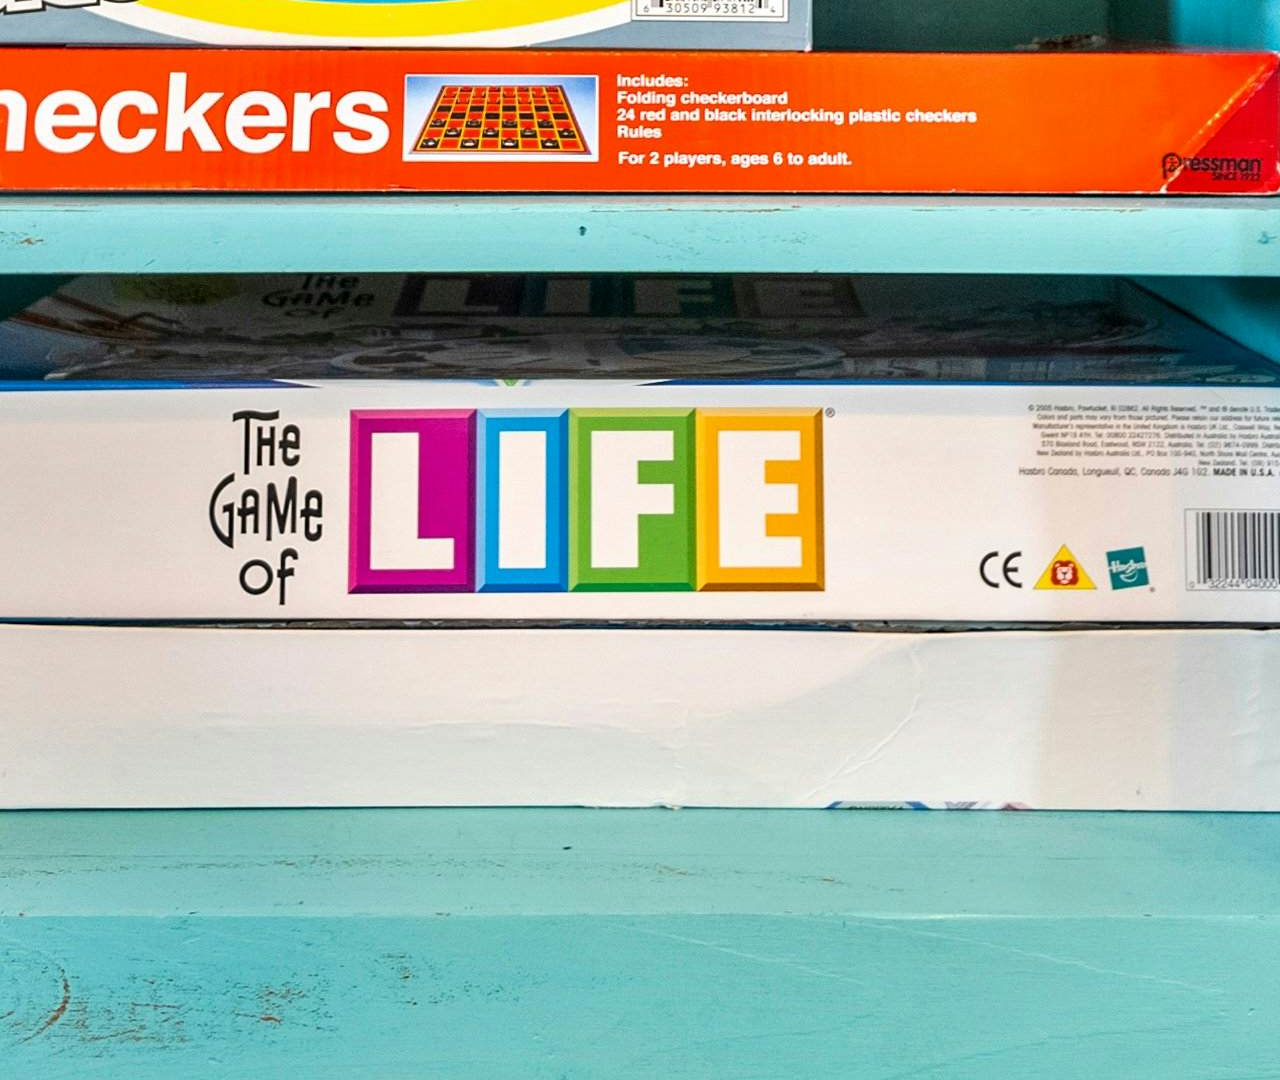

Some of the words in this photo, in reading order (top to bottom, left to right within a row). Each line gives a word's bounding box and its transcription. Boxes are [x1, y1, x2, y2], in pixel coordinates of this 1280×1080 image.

[665, 2, 707, 14] 30509
[713, 3, 756, 15] 93812
[616, 73, 689, 88] Includes:
[616, 90, 677, 108] Folding
[680, 91, 788, 105] checkerboard
[616, 108, 636, 122] 24
[639, 108, 666, 122] red
[670, 108, 700, 122] and
[704, 108, 747, 122] black
[751, 108, 845, 126] interlocking
[848, 108, 902, 126] plastic
[905, 108, 978, 123] checkers
[617, 125, 663, 139] Rules
[617, 151, 646, 165] For
[649, 151, 660, 165] 2
[664, 151, 727, 168] players,
[730, 153, 769, 168] ages
[772, 151, 783, 165] 6
[787, 152, 804, 166] to
[807, 151, 853, 166] adult.
[416, 275, 838, 313] LIFE
[1213, 467, 1237, 477] MADE
[1238, 467, 1248, 477] IN
[368, 428, 804, 570] LIFE
[979, 550, 1023, 589] CE
